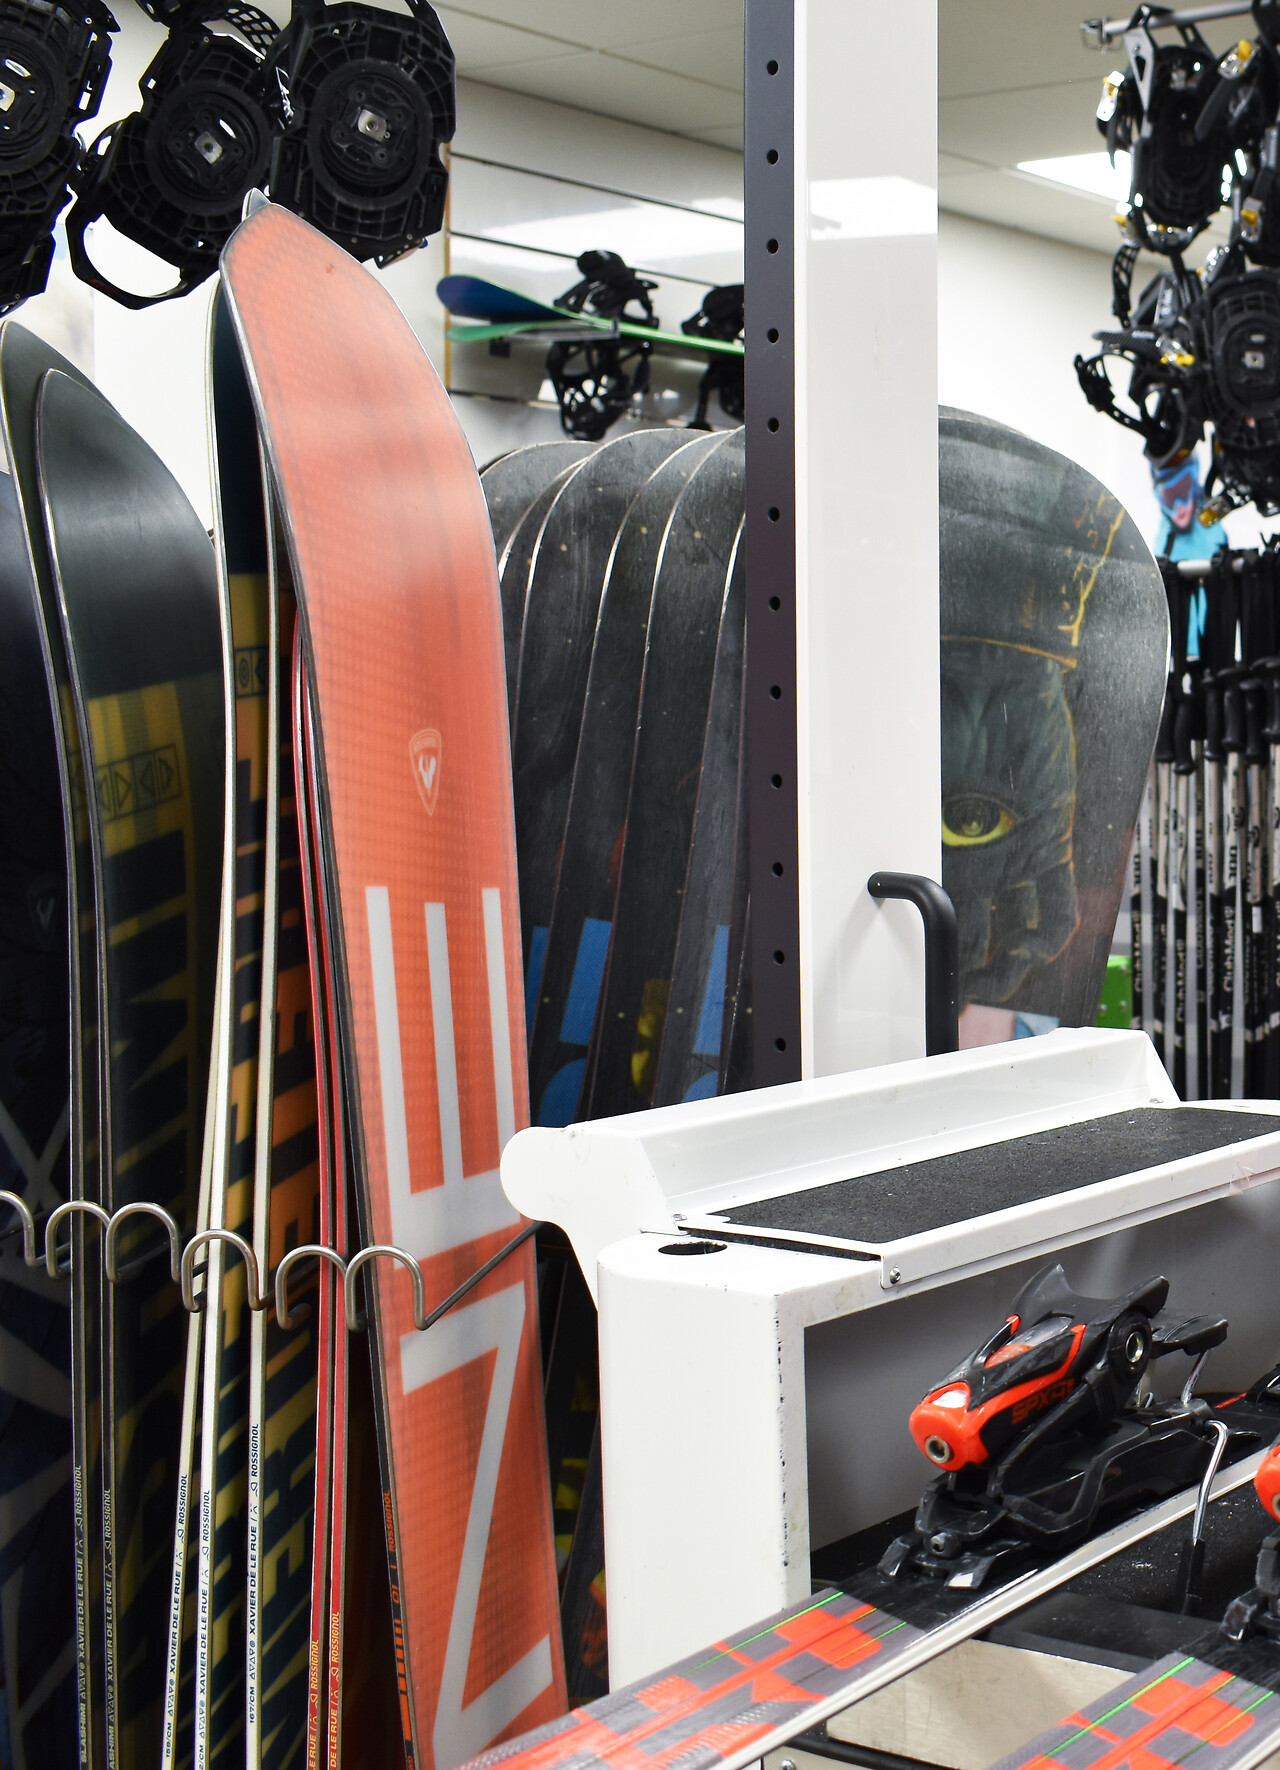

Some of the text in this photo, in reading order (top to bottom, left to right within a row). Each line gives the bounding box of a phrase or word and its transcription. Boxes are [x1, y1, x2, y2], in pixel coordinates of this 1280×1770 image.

[251, 1424, 259, 1478] ROSSIGNOL
[74, 1465, 83, 1515] ROSSIGNOL
[178, 1474, 188, 1525] ROSSIGNOL
[104, 1488, 112, 1539] ROSSIGNOL
[202, 1490, 211, 1542] ROSSIGNOL
[250, 1525, 258, 1552] RUE
[76, 1557, 84, 1580] RUE
[174, 1570, 182, 1595] RUE
[250, 1554, 257, 1569] LE
[250, 1572, 257, 1588] DE
[105, 1581, 113, 1605] RUE
[201, 1589, 209, 1613] RUE
[249, 1590, 257, 1635] XAVIER
[78, 1616, 86, 1659] XAVIER
[172, 1612, 179, 1629] DE
[201, 1632, 207, 1649] DE
[331, 1611, 340, 1663] ROSSIGNOL
[107, 1638, 115, 1681] XAVIER
[169, 1631, 178, 1674] XAVIER
[199, 1651, 207, 1695] XAVIER
[310, 1639, 319, 1690] ROSSIGNOL
[309, 1737, 317, 1759] RUE
